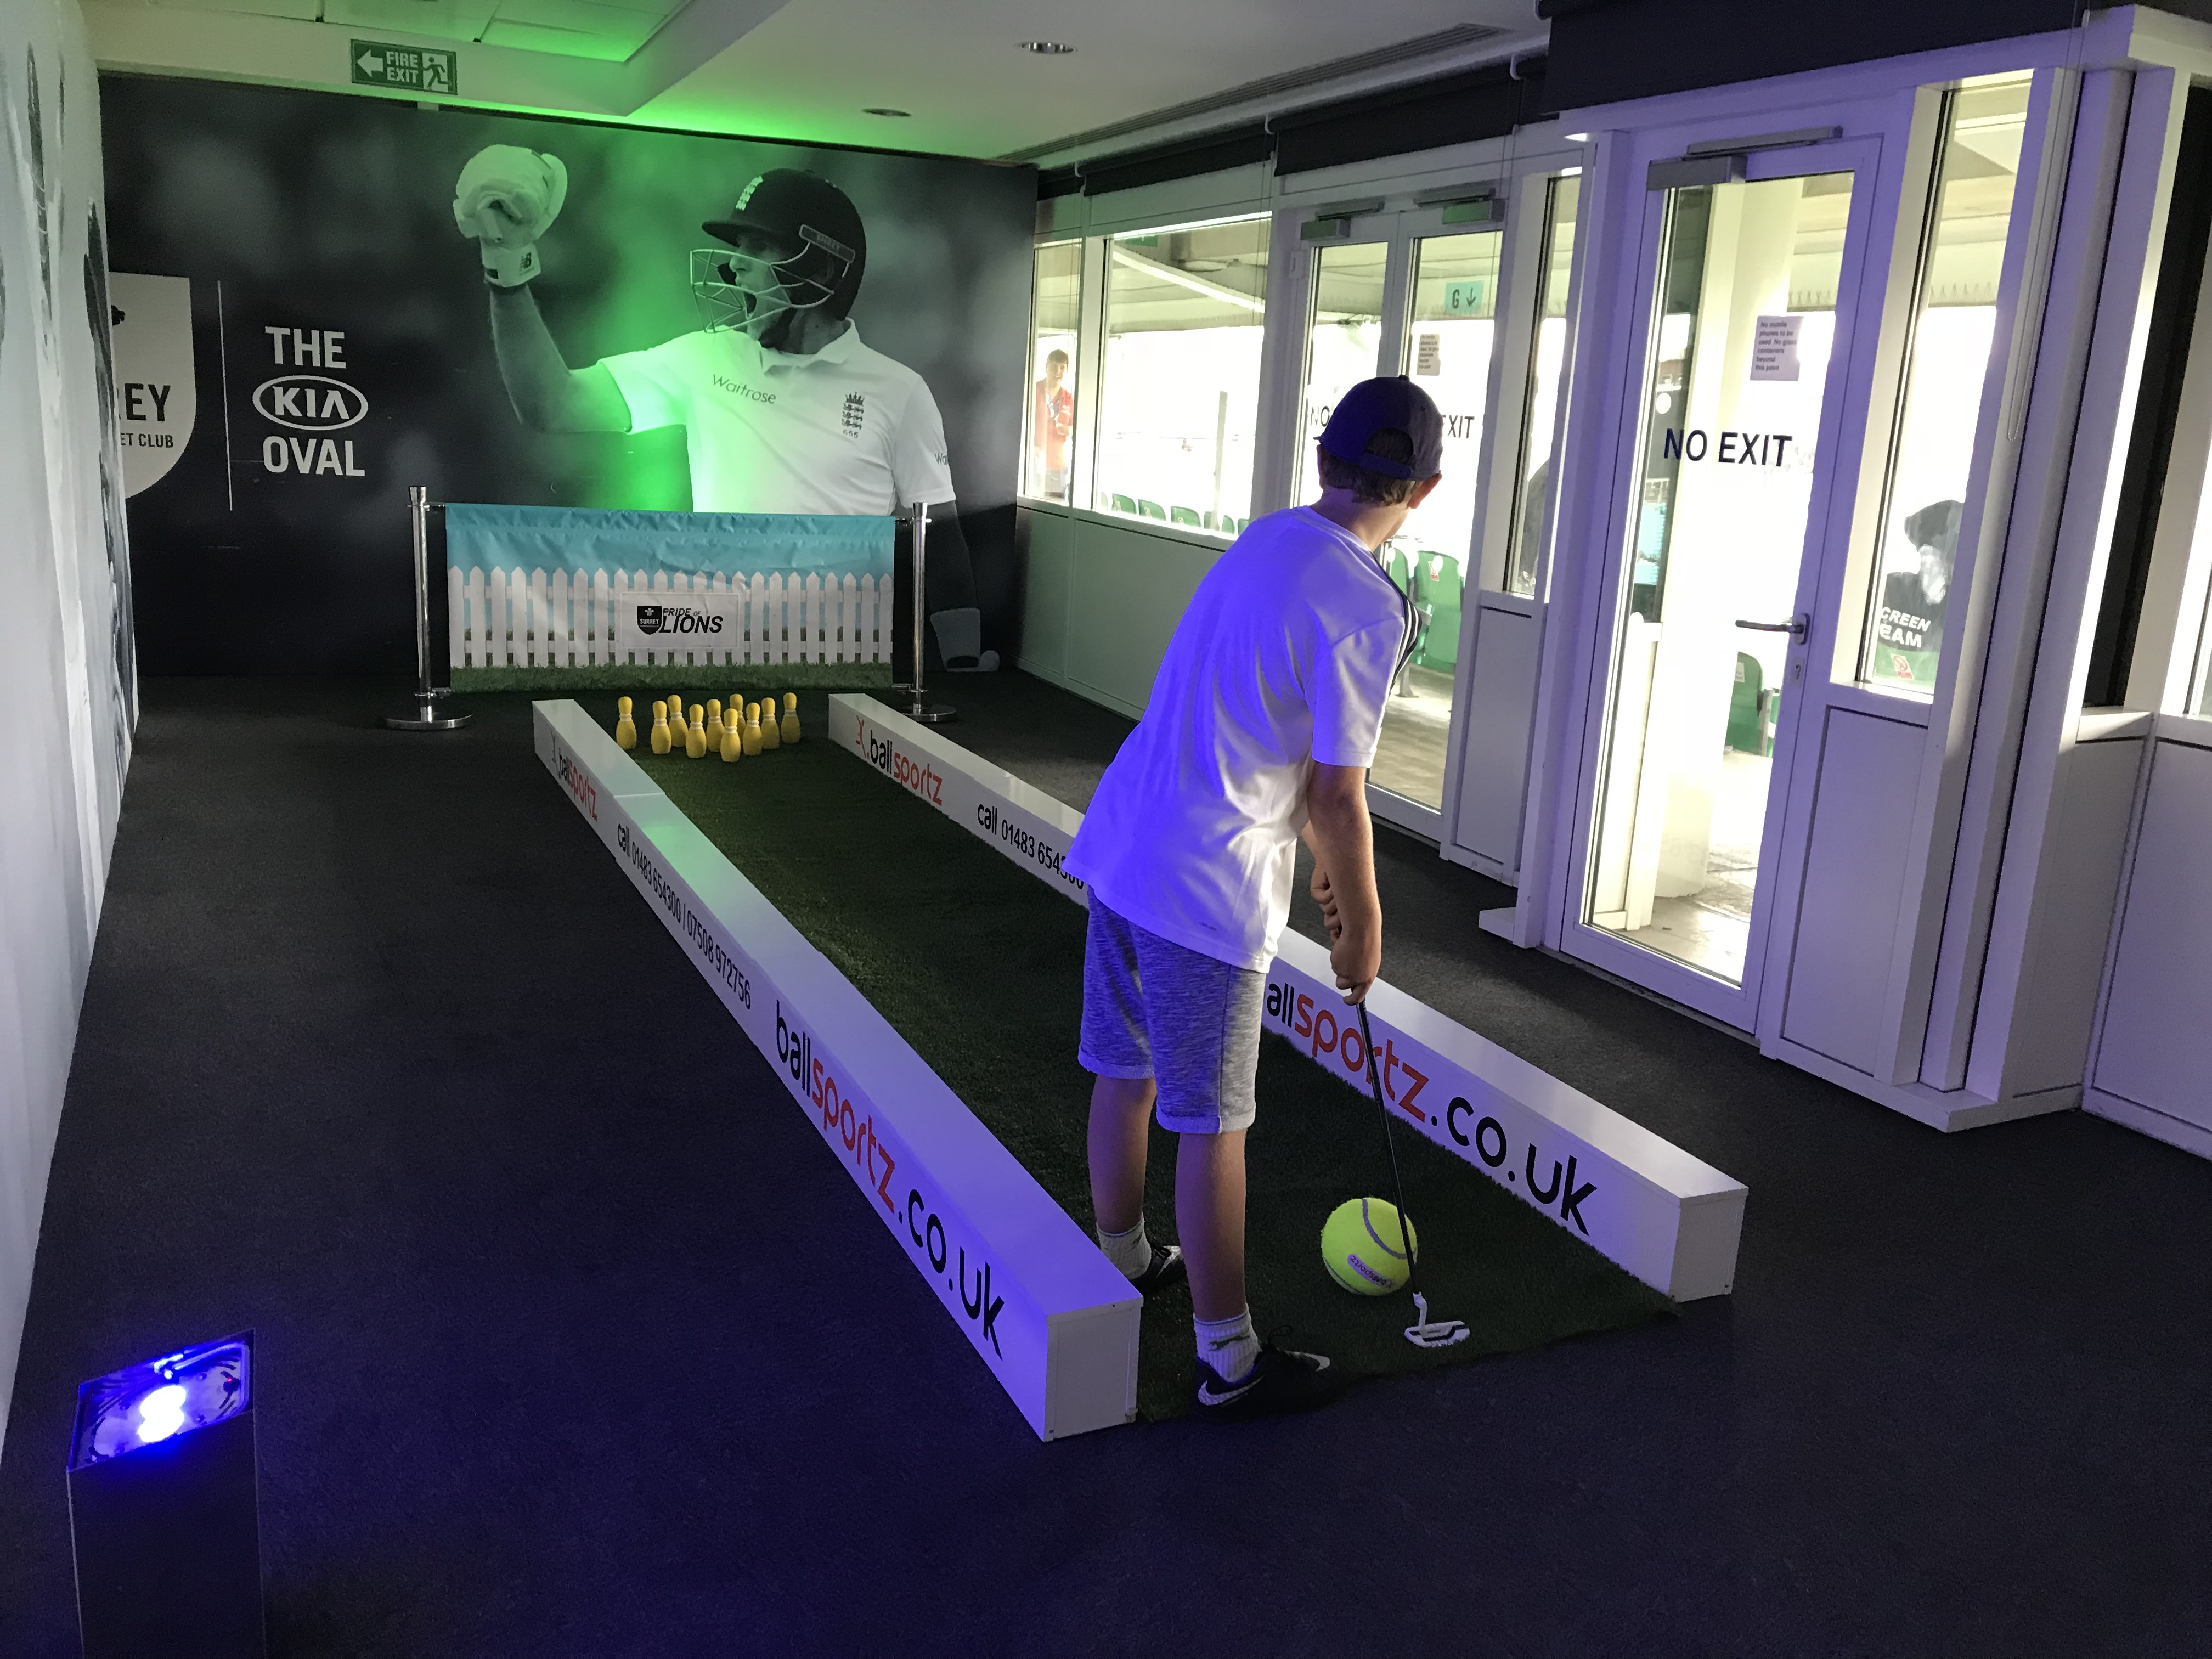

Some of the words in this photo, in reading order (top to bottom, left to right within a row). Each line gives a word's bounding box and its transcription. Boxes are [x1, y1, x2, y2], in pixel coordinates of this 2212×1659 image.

[386, 51, 419, 67] FIRE
[387, 67, 419, 83] EXIT
[1452, 289, 1459, 309] G
[264, 326, 346, 369] THE
[273, 386, 349, 419] KIA
[713, 374, 776, 404] Waitrose
[1310, 405, 1330, 427] NO
[138, 433, 173, 448] CLUB
[1664, 428, 1708, 461] NO
[1718, 431, 1793, 467] EXIT
[263, 436, 365, 477] OVAL
[659, 616, 723, 633] LIONS
[663, 608, 691, 616] PRIDE
[870, 730, 943, 806] ballsportz
[977, 804, 998, 836] call
[1001, 819, 1035, 859] 01483
[617, 823, 630, 858] call
[632, 841, 652, 885] 01483
[653, 868, 681, 923] 654300
[687, 910, 713, 964] 07508
[715, 944, 751, 1011] 972756
[776, 1000, 1005, 1361] ballsportz.co.uk
